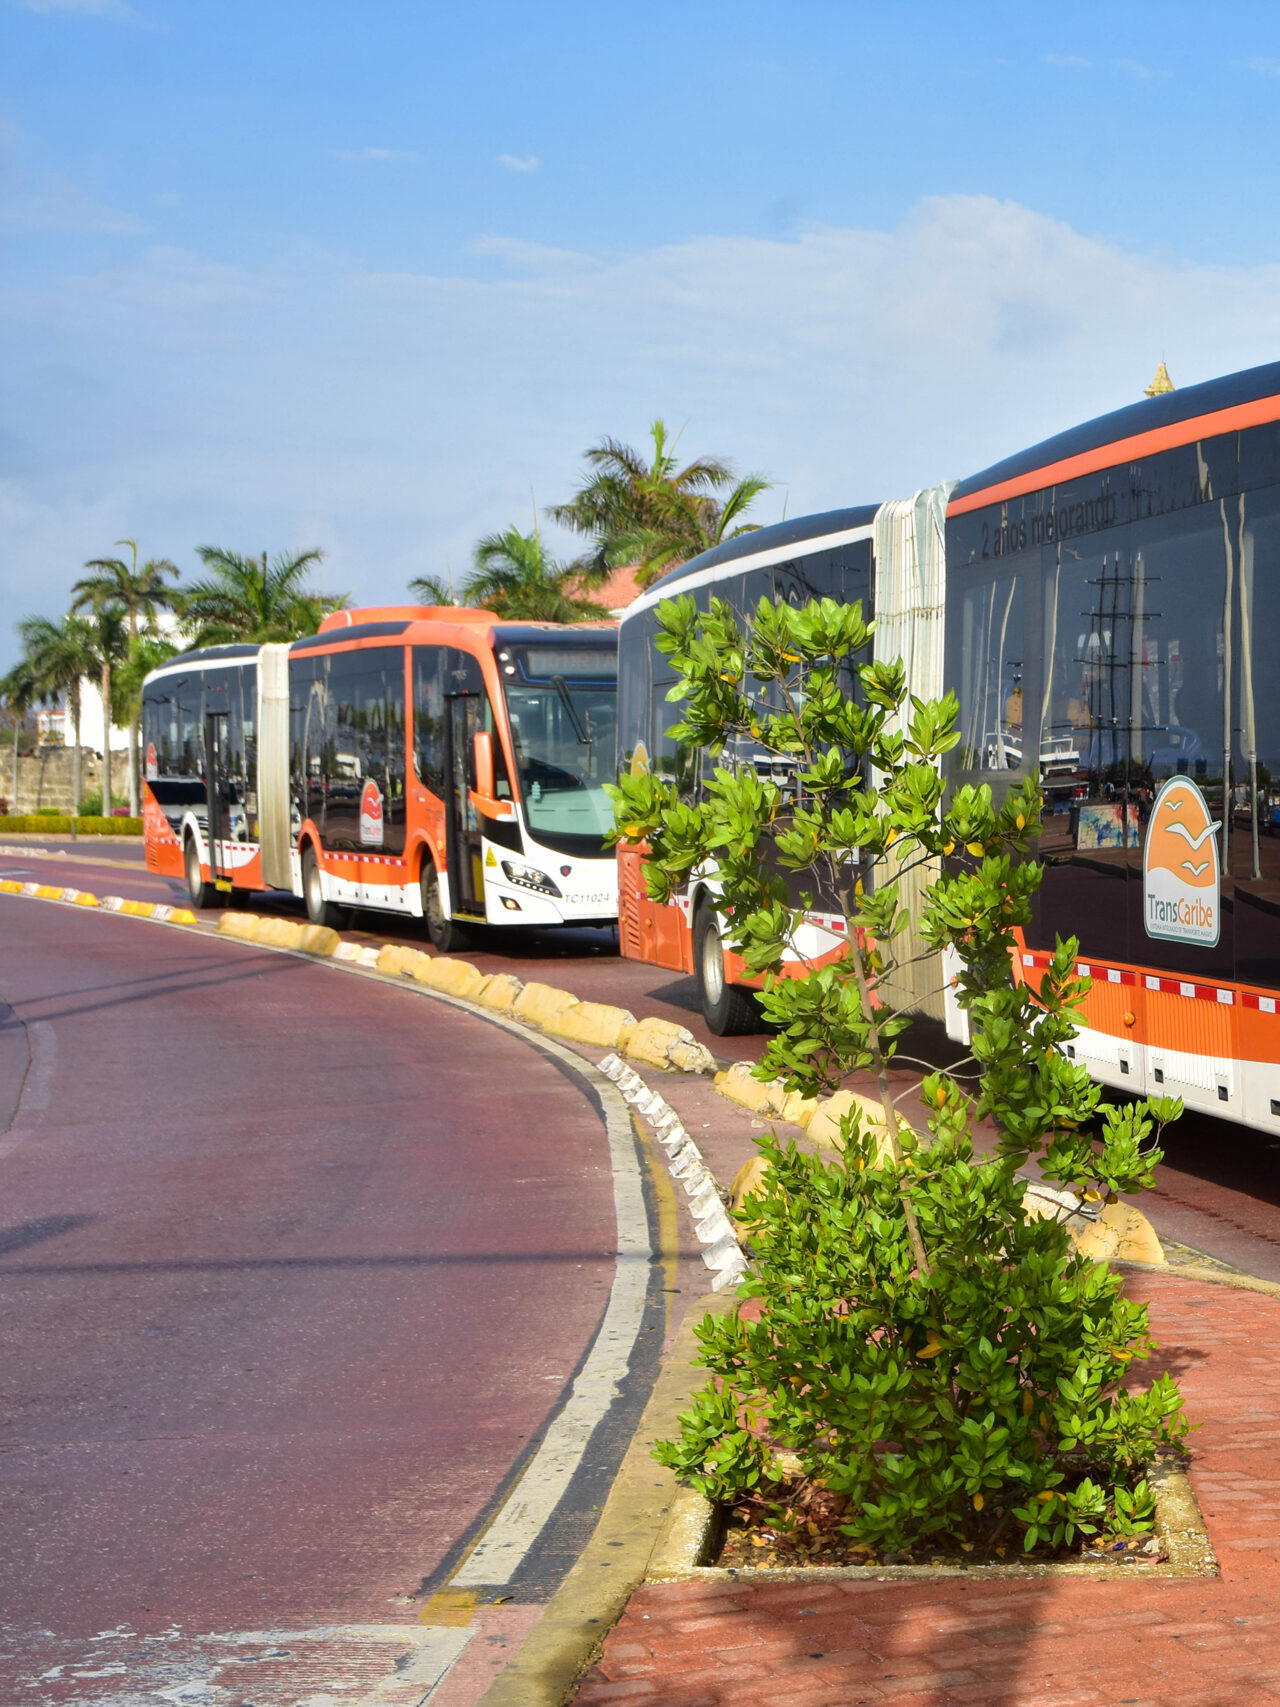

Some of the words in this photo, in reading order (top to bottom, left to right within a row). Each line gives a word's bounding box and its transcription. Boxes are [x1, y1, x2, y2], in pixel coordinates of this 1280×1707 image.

[981, 521, 991, 560] 2
[993, 522, 1027, 557] años
[1147, 893, 1213, 928] TransCaribe
